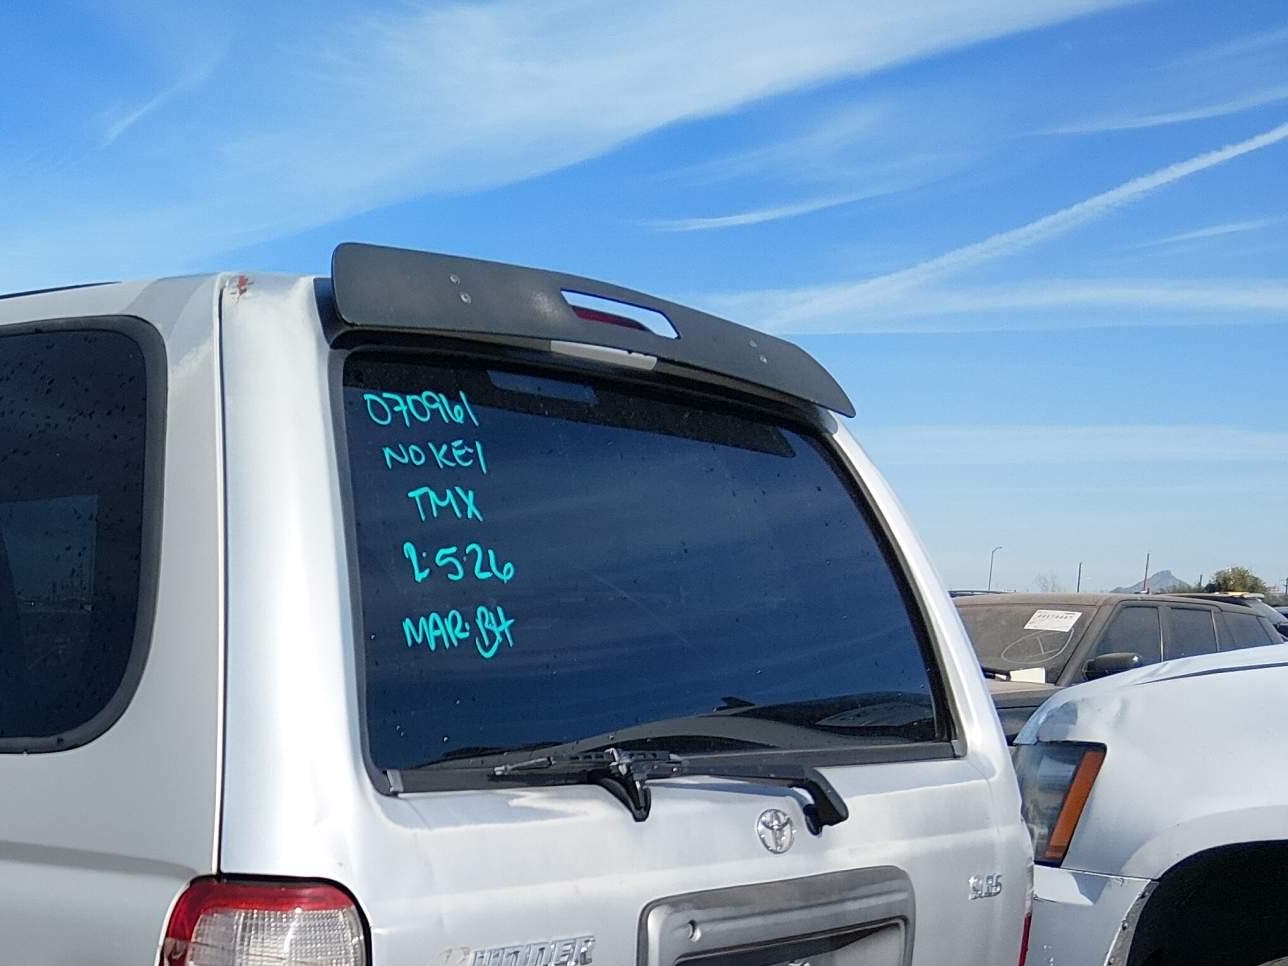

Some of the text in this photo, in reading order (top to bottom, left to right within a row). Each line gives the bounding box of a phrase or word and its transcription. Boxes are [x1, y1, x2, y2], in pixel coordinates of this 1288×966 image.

[363, 390, 480, 428] 070961
[382, 443, 426, 470] NO
[407, 486, 484, 522] TMX
